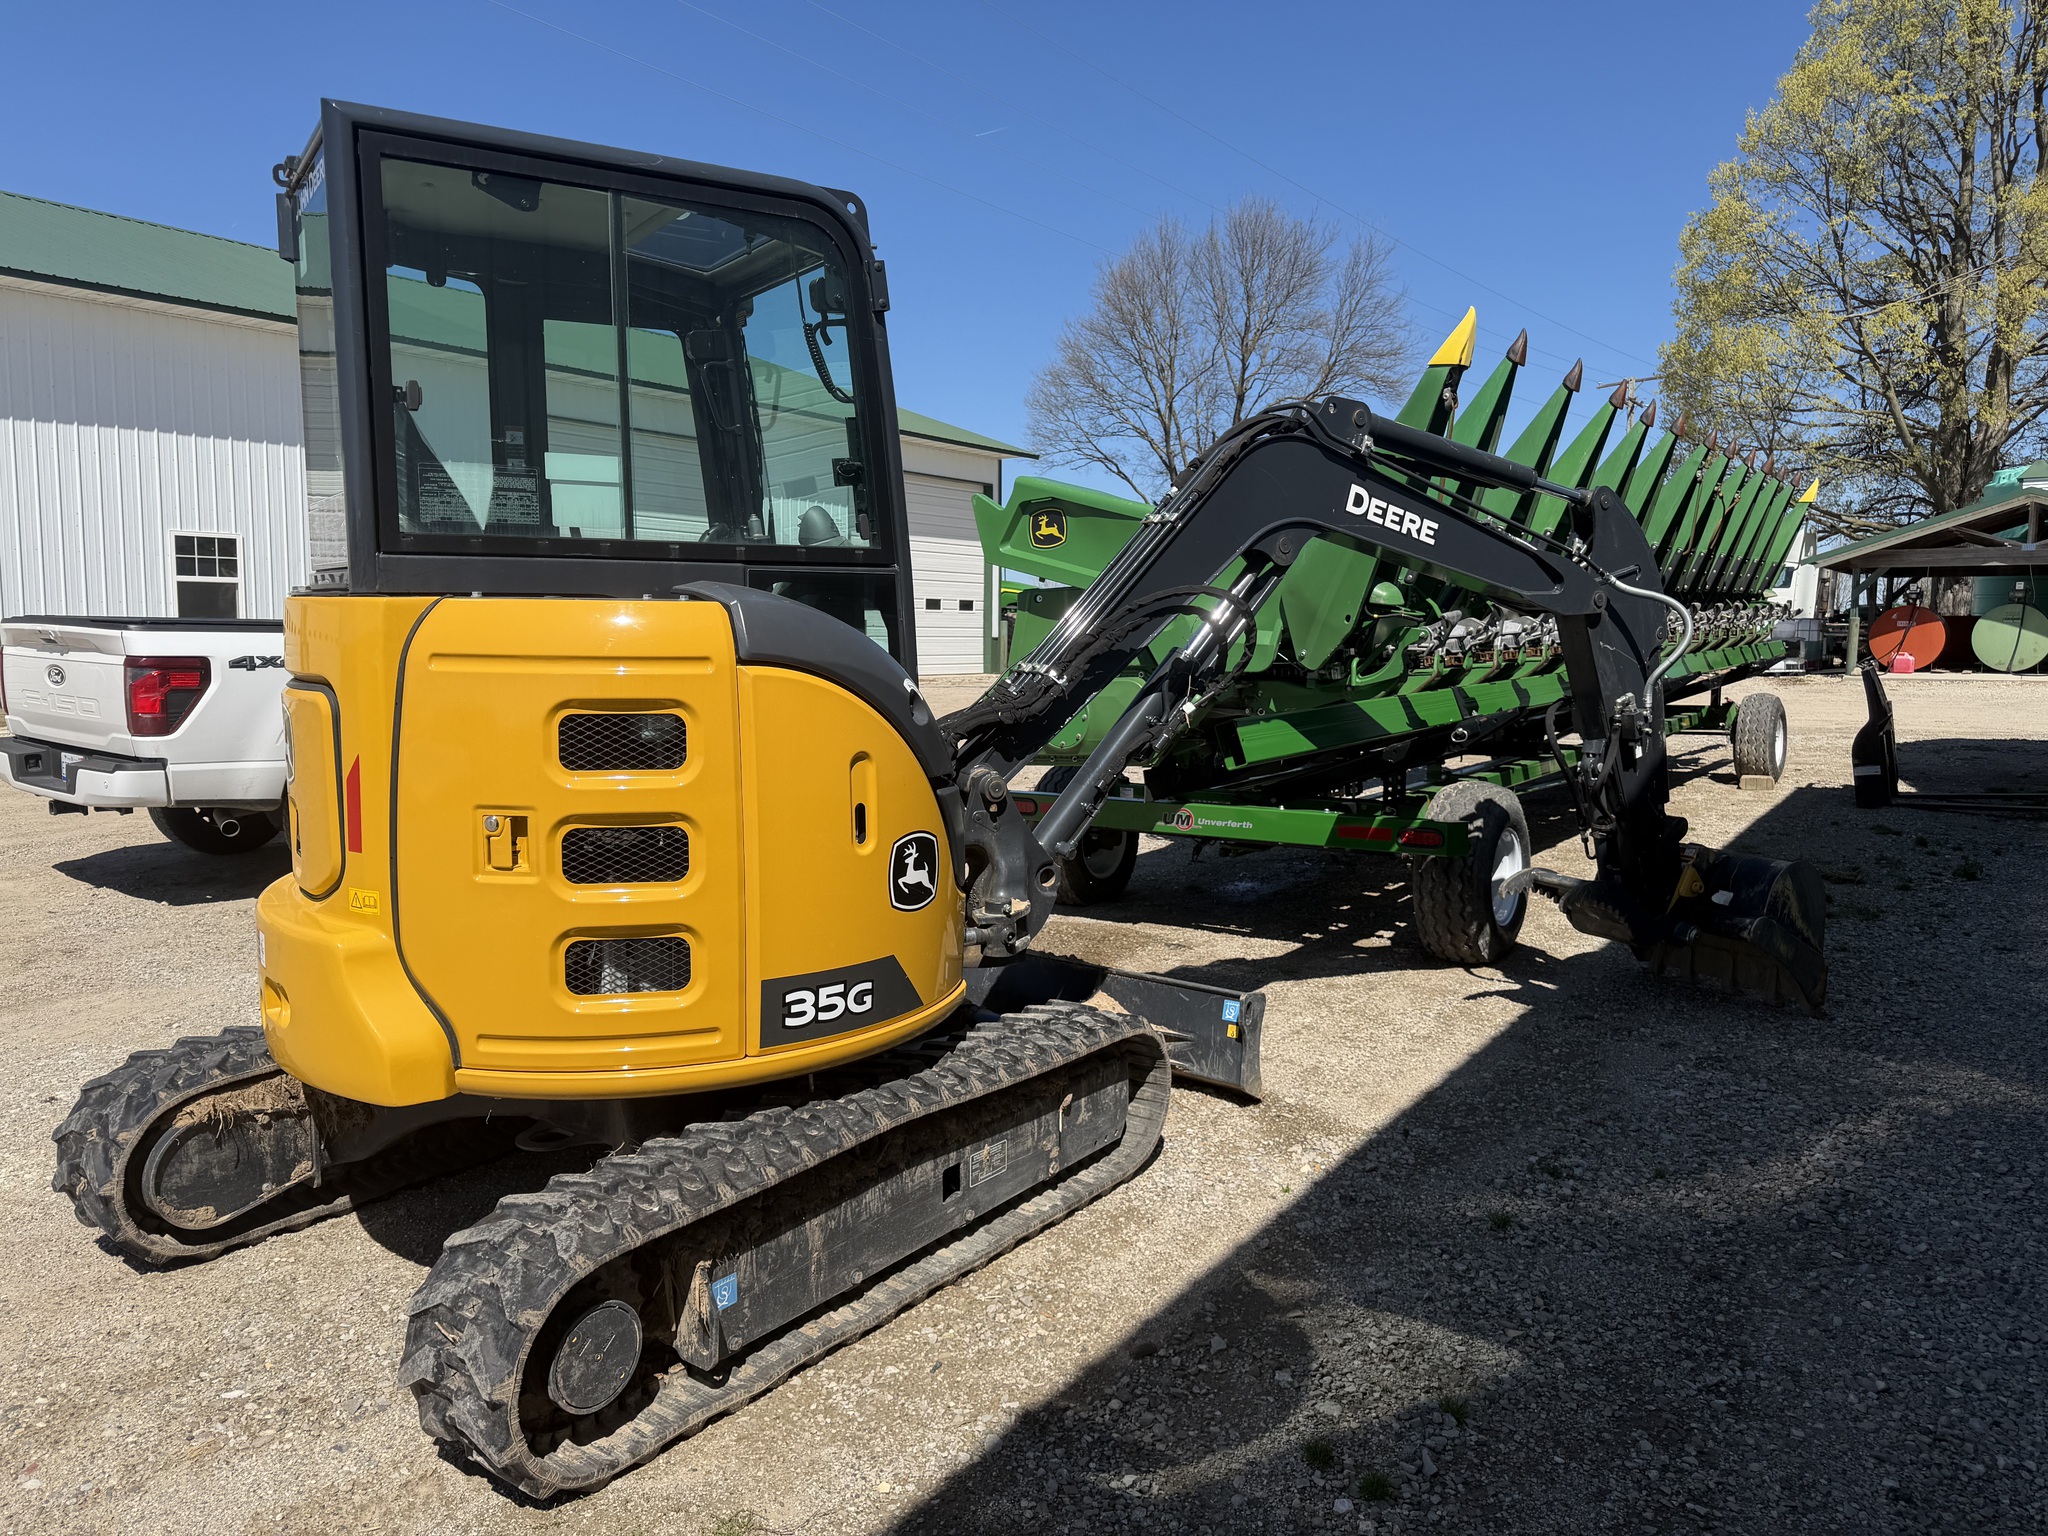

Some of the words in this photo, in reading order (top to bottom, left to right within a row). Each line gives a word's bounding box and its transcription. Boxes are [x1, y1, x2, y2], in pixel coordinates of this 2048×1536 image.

[309, 156, 325, 200] DEER
[1345, 483, 1440, 546] DEERE
[228, 655, 285, 671] 4X
[21, 688, 101, 719] F-150
[1163, 811, 1192, 827] UM
[1197, 817, 1253, 829] Unverferth
[783, 980, 873, 1028] 35G
